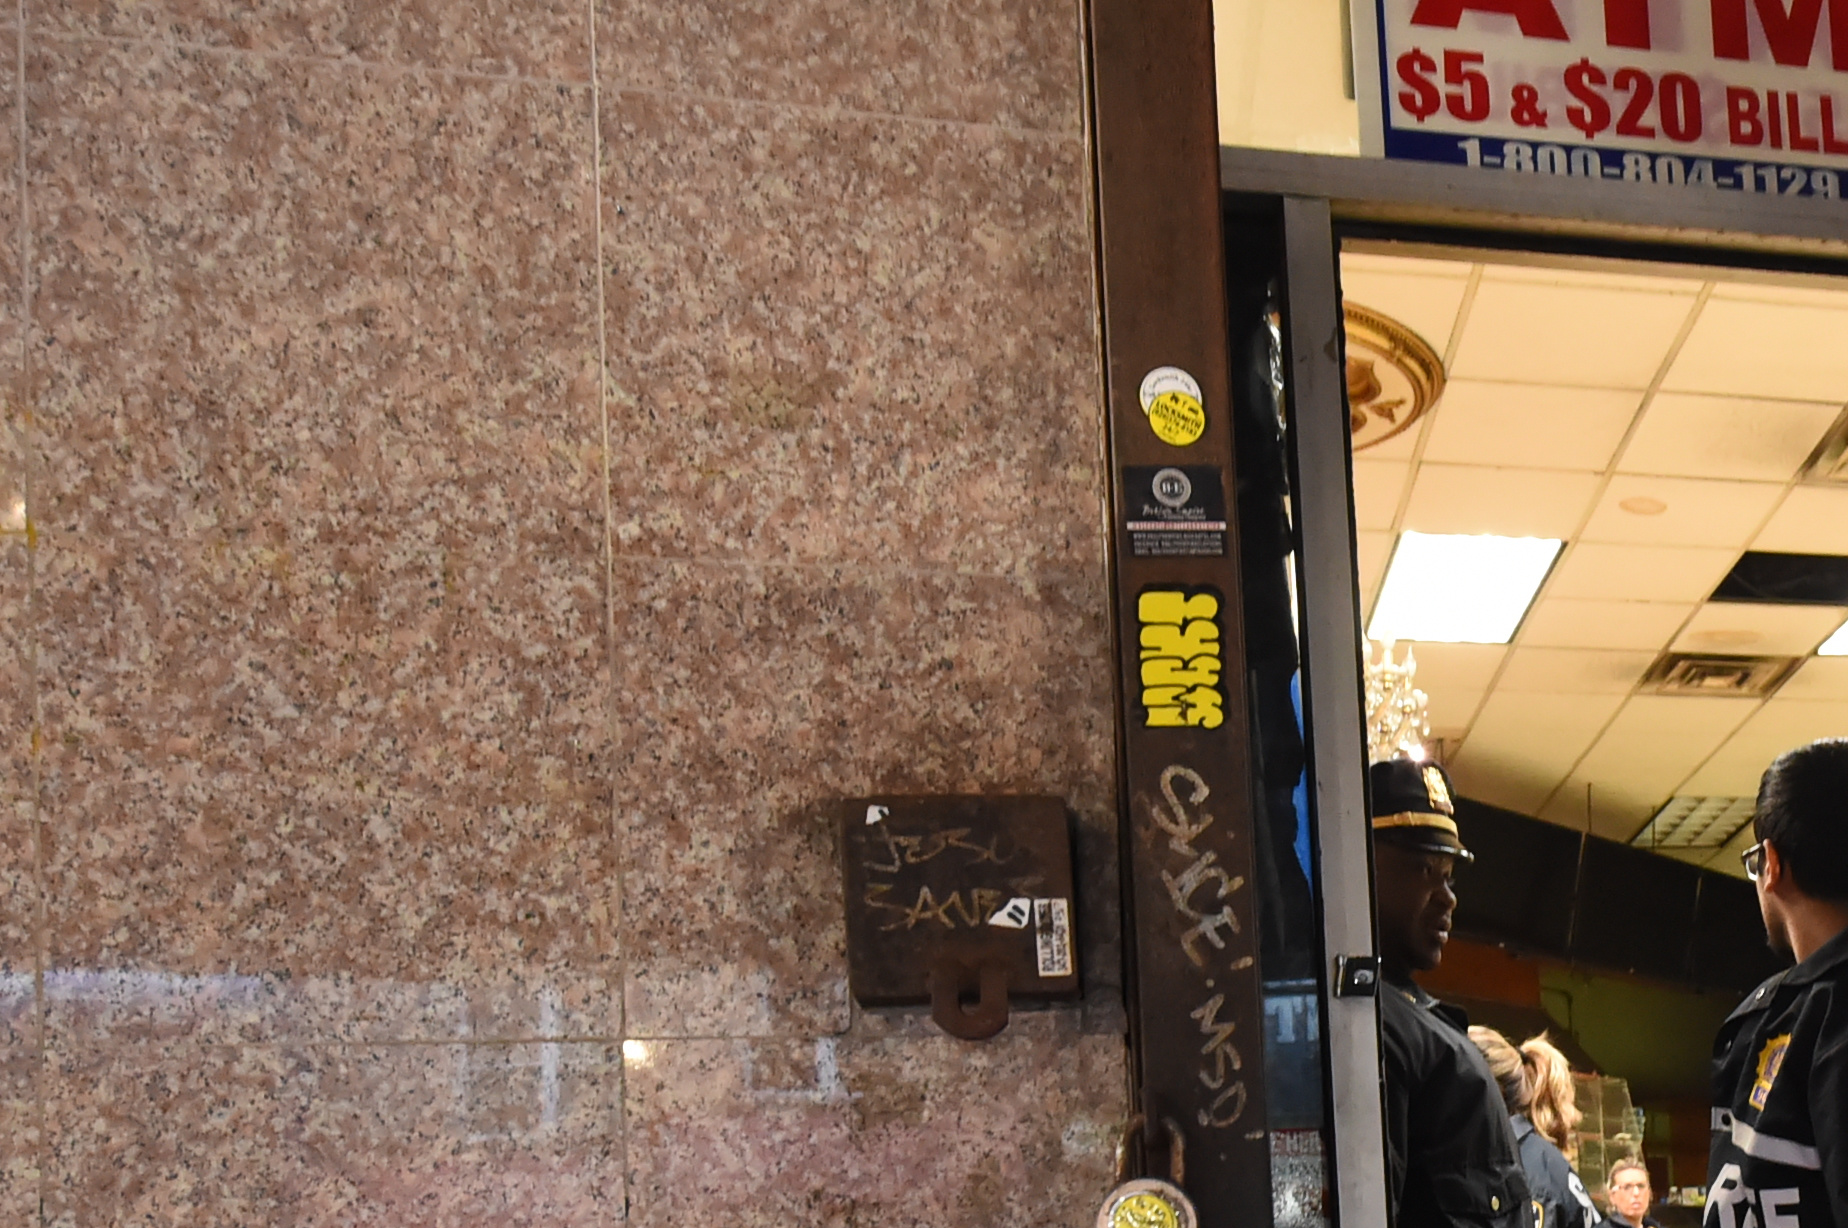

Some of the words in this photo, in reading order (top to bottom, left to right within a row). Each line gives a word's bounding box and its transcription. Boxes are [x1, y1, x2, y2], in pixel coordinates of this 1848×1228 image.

[1397, 47, 1492, 123] $5
[1511, 82, 1548, 129] &
[1563, 57, 1704, 140] $20
